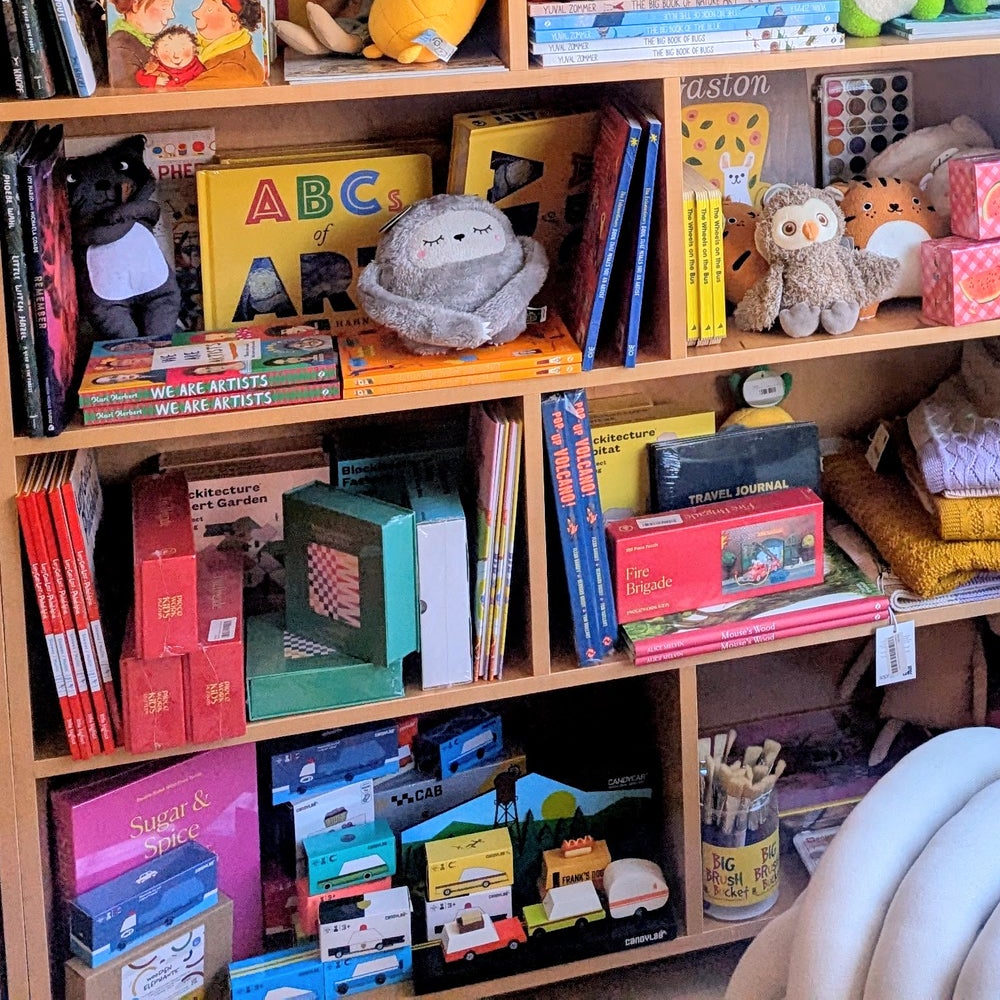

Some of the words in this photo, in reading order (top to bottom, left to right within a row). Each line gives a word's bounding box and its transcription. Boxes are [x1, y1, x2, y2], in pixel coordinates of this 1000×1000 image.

[543, 6, 566, 15] YUVAL
[569, 4, 597, 13] ZOMMER
[632, 0, 646, 10] THE
[649, 0, 660, 8] BIG
[700, 46, 714, 54] BUGS
[13, 68, 25, 93] KNOPF
[680, 72, 771, 100] aston
[3, 174, 13, 204] PHOEBE
[6, 208, 15, 229] WAHL
[313, 223, 333, 246] of
[703, 250, 707, 258] on
[715, 248, 720, 256] on
[11, 255, 22, 280] LITTLE
[232, 247, 377, 322] AR
[15, 284, 25, 312] WITCH
[34, 276, 48, 329] REMEMBER
[18, 315, 28, 340] HAZEL
[151, 386, 175, 400] WE
[180, 381, 207, 396] ARE
[210, 374, 269, 392] ARTISTS
[155, 402, 179, 416] WE
[184, 398, 209, 413] ARE
[213, 392, 272, 411] ARTISTS
[592, 428, 656, 446] ckitecture
[554, 448, 576, 508] VOLCANO!
[576, 438, 596, 498] VOLCANO!
[189, 484, 260, 500] ckitecture
[192, 501, 214, 510] ert
[217, 495, 268, 508] Garden
[688, 489, 732, 505] TRAVEL
[735, 479, 789, 496] JOURNAL
[626, 567, 650, 581] Fire
[626, 577, 672, 596] Brigade
[721, 627, 753, 640] Mouse's
[755, 623, 776, 633] Wood
[415, 785, 443, 801] CAB
[130, 802, 188, 838] Sugar
[192, 790, 211, 811] &
[144, 824, 199, 858] Spice
[712, 853, 735, 871] BIG
[562, 871, 590, 884] FRANK'S
[706, 867, 743, 886] BRUSH
